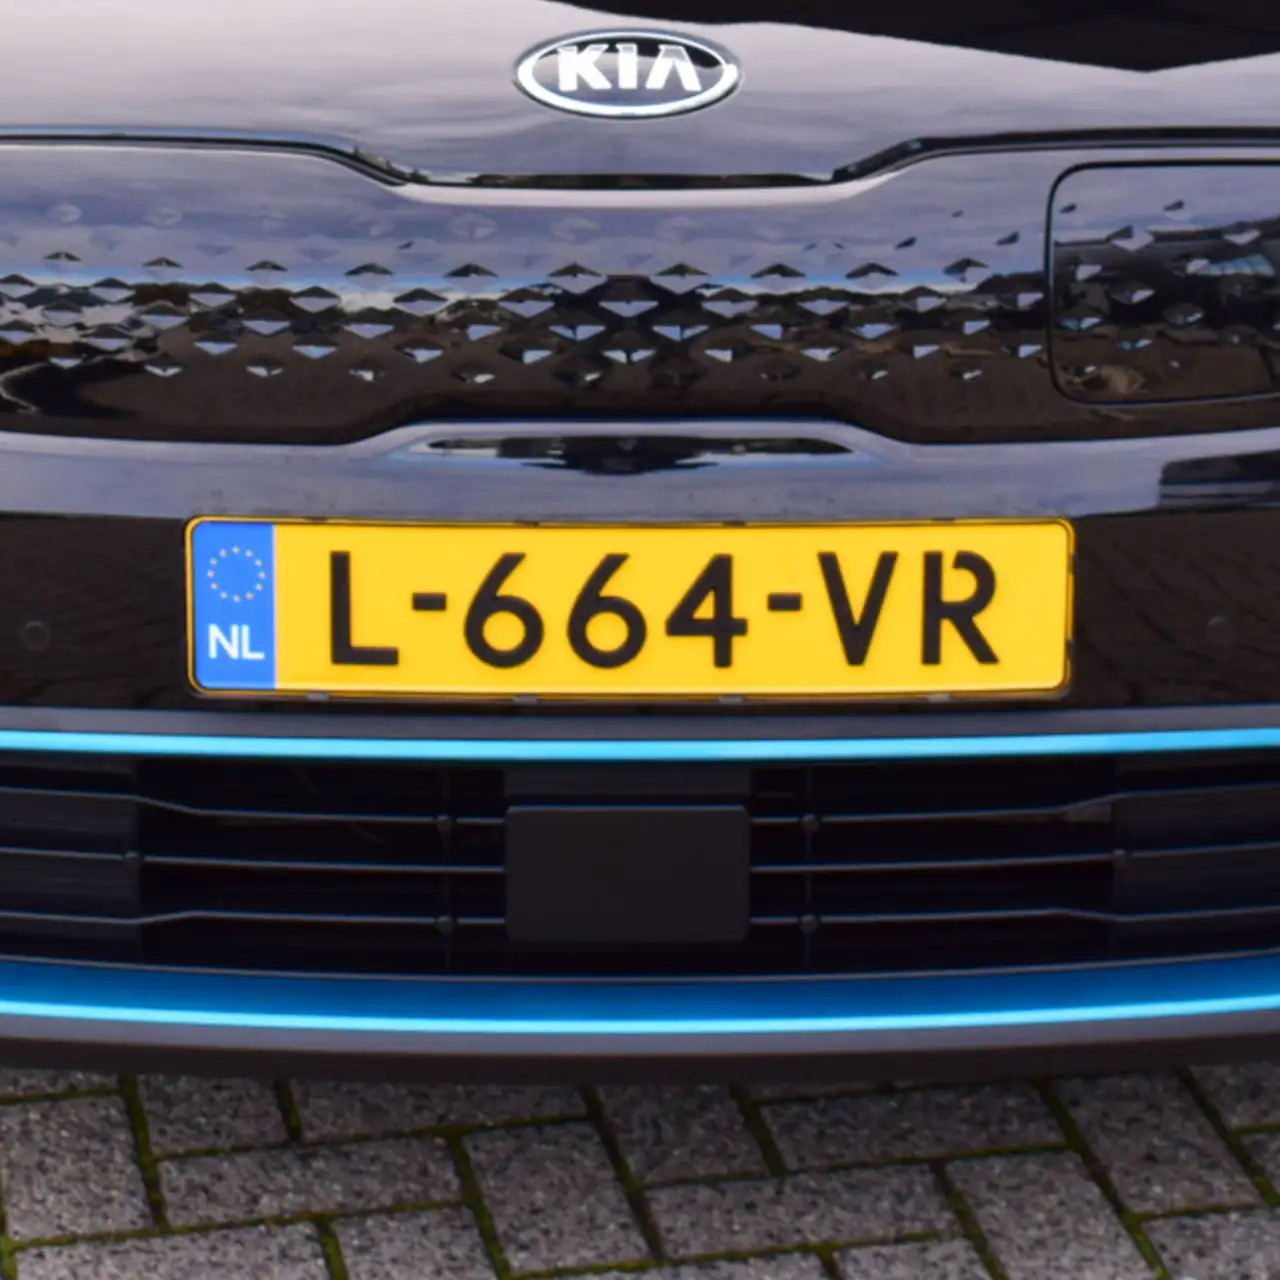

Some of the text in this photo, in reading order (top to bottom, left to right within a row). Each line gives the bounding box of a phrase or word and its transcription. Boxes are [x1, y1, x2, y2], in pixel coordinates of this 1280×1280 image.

[555, 42, 703, 91] KIA
[329, 551, 1000, 669] L-664-VR
[207, 625, 265, 661] NL
